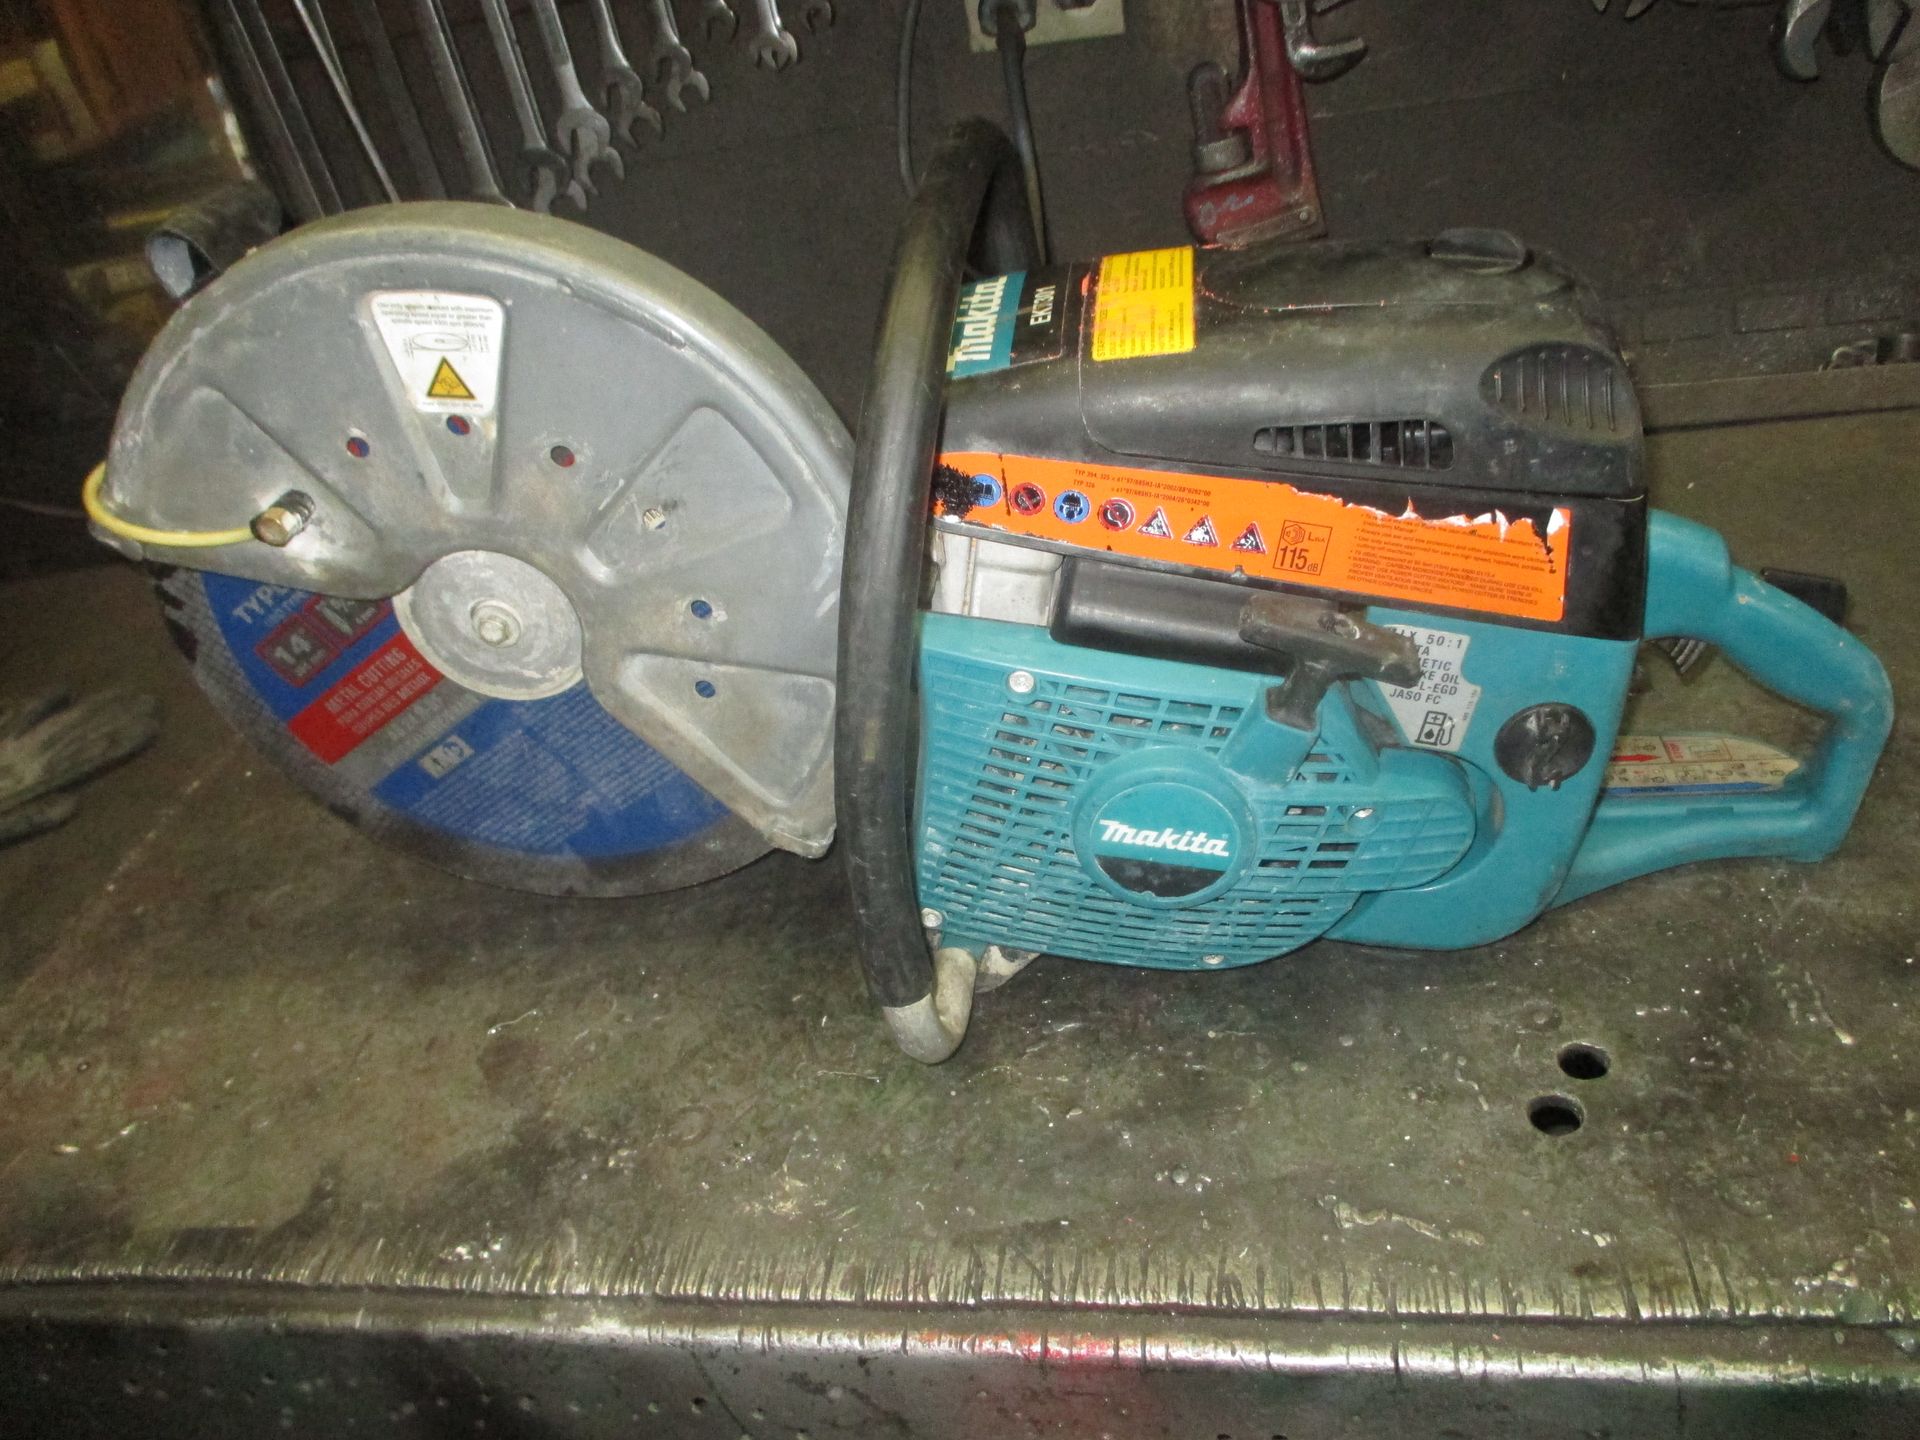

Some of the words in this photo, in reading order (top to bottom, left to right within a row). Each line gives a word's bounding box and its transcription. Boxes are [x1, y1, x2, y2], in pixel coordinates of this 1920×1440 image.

[1280, 546, 1309, 571] 115
[1307, 563, 1319, 574] dB
[1426, 634, 1463, 649] 50:1
[357, 648, 407, 688] CUTTING
[1440, 673, 1460, 685] OIL
[1389, 688, 1421, 702] JASO
[1425, 693, 1442, 705] FC
